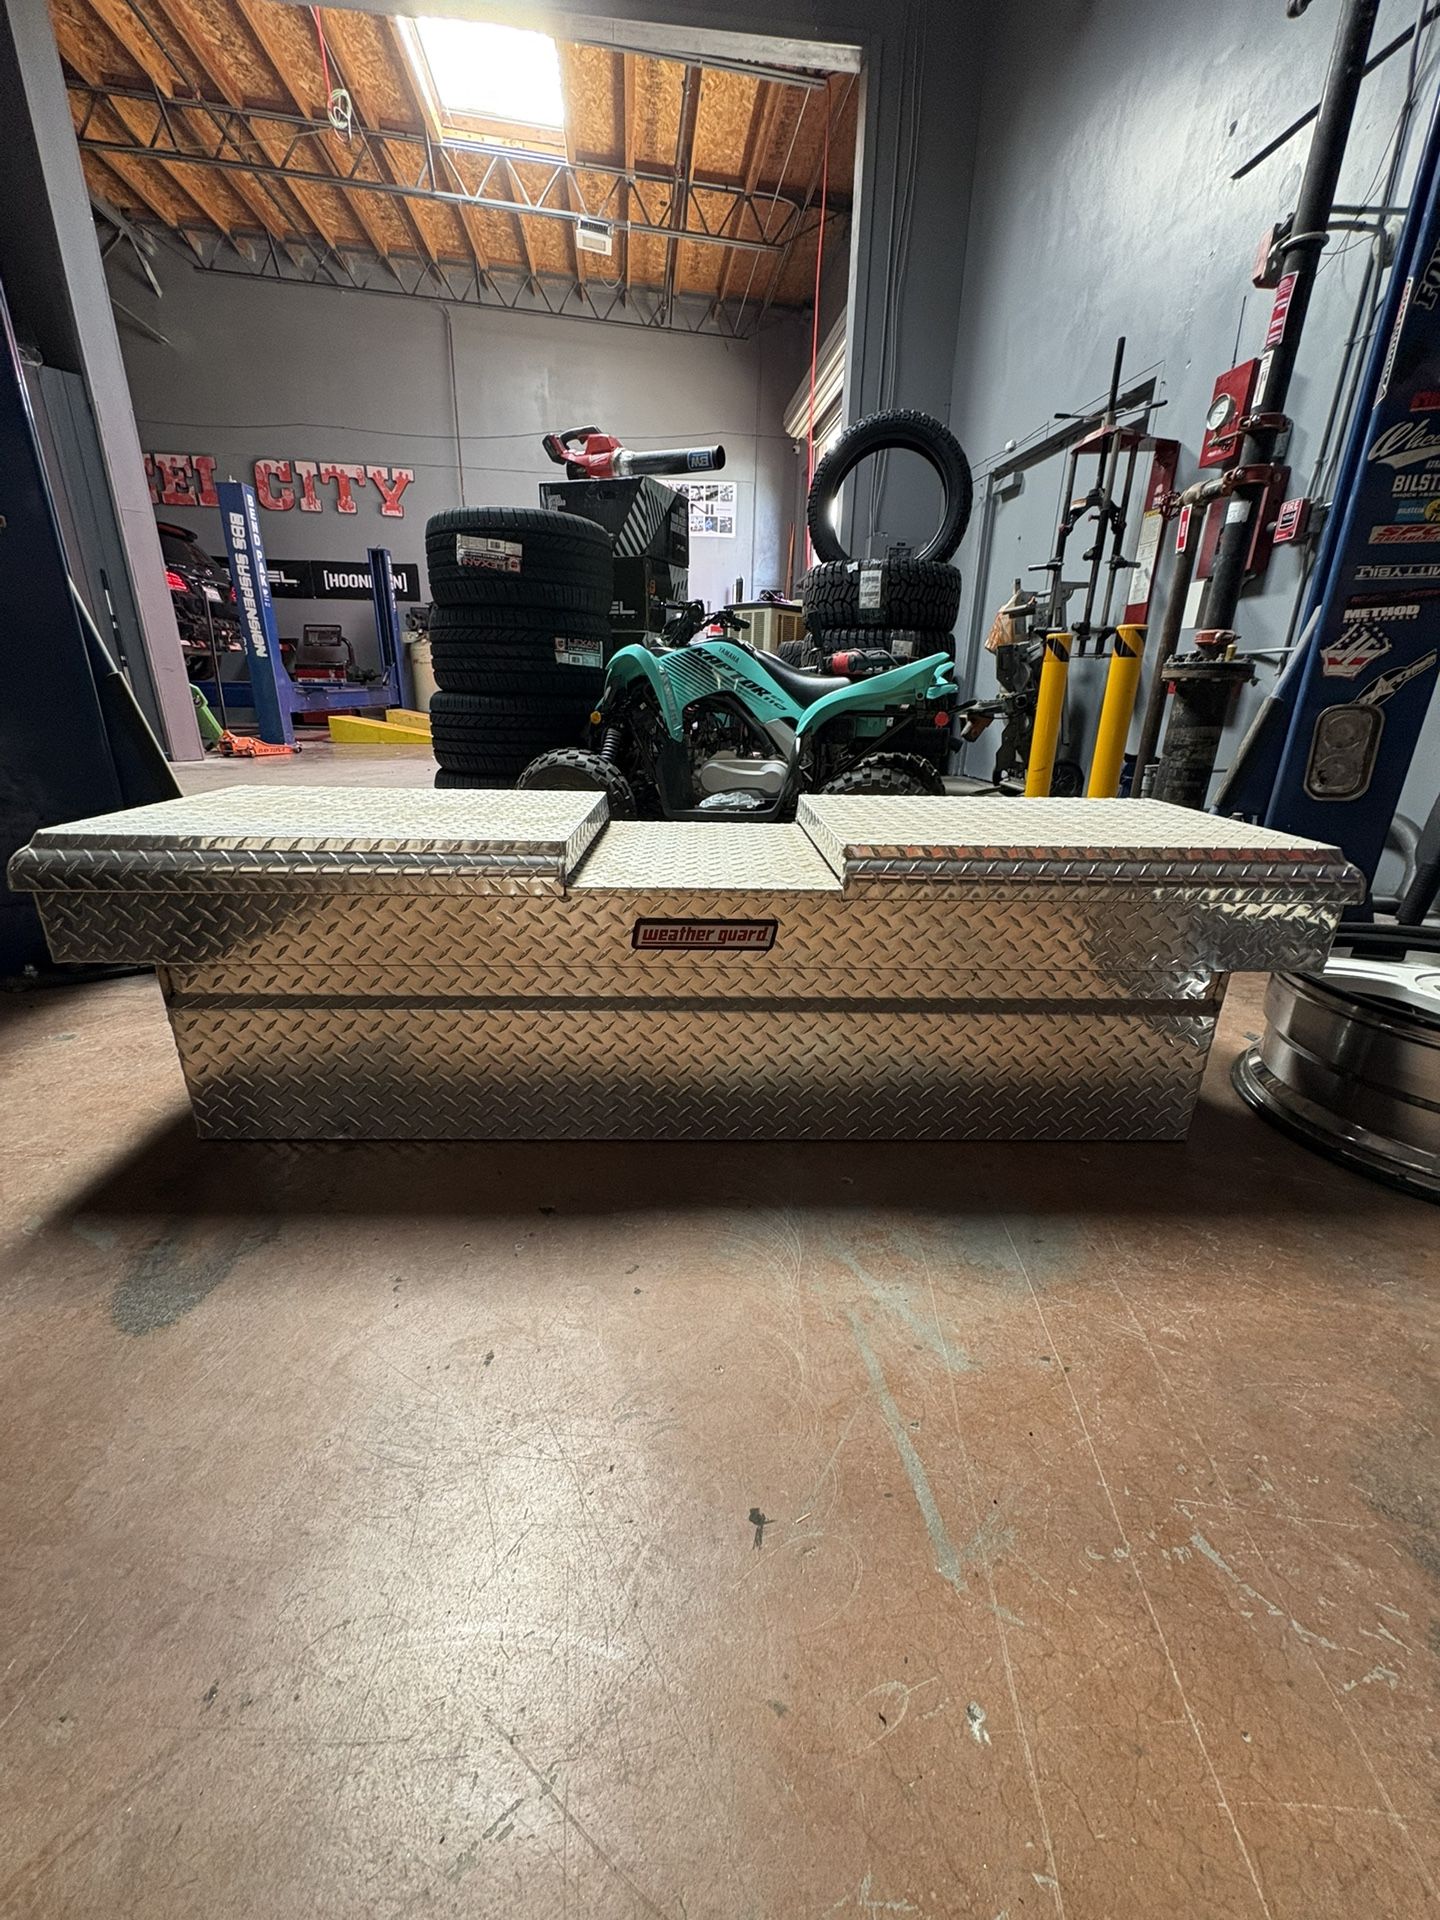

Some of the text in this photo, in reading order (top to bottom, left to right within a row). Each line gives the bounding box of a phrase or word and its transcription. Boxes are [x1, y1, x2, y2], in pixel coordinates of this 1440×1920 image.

[254, 459, 413, 517] CITY
[1391, 473, 1440, 492] BILST
[1282, 500, 1300, 511] FIRE
[247, 494, 261, 546] BEND
[256, 550, 267, 588] PAK
[323, 570, 408, 592] [HOONIN]
[1359, 565, 1440, 578] MITTYBILT
[235, 553, 268, 657] SUSPENSION
[1344, 605, 1420, 620] METHOD
[718, 645, 740, 664] YAMAHA
[690, 647, 772, 697] RAPTOR
[642, 926, 769, 944] weather guard
